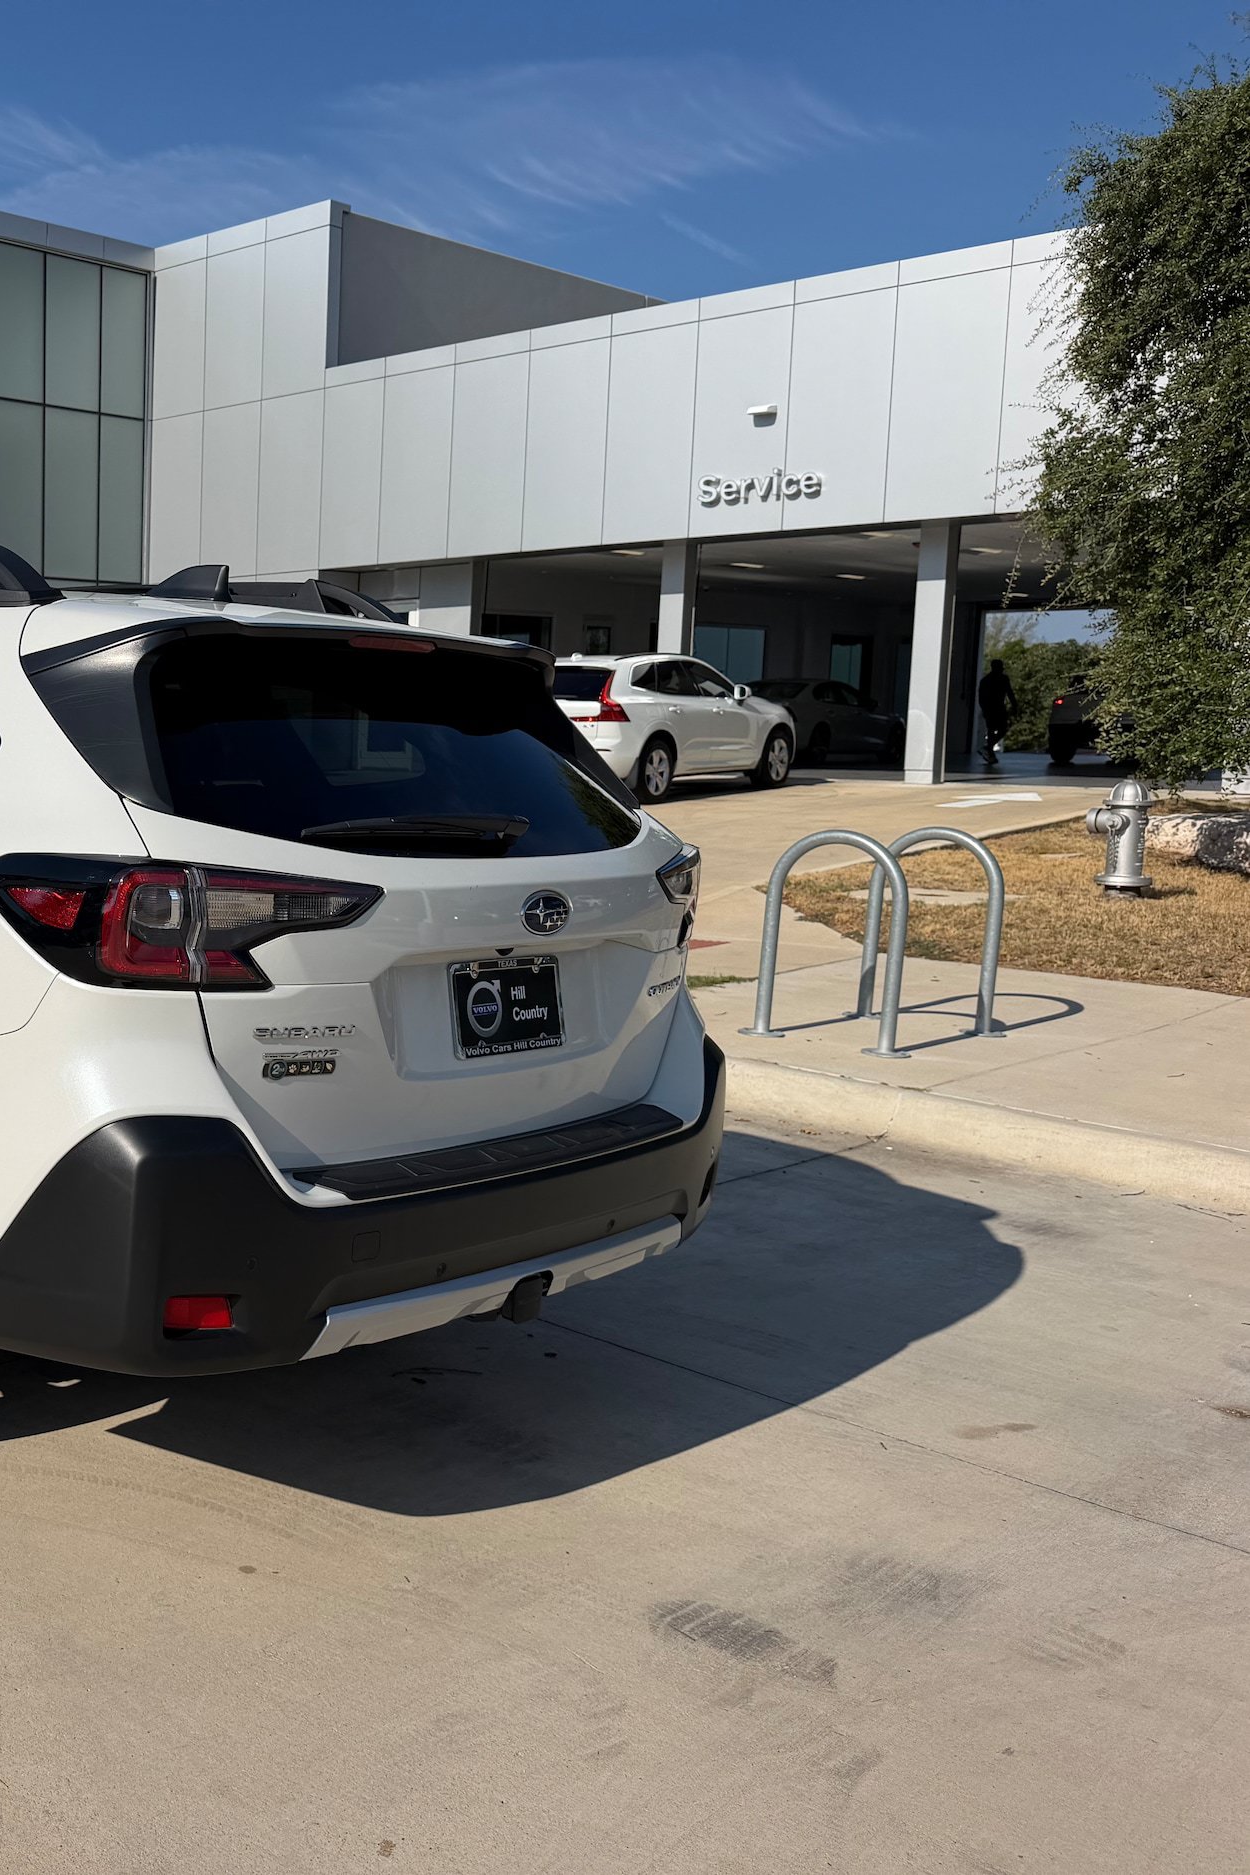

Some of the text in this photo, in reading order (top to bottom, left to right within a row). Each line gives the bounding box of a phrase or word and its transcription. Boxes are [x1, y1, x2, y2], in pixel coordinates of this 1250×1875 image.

[697, 467, 820, 503] Service
[497, 959, 518, 968] TEXAS
[510, 985, 526, 1000] Hill
[472, 1004, 498, 1014] VOLVO
[512, 1005, 548, 1021] Country
[253, 1025, 356, 1040] SUBARU
[465, 1038, 561, 1056] Volvo Cars Hill Country
